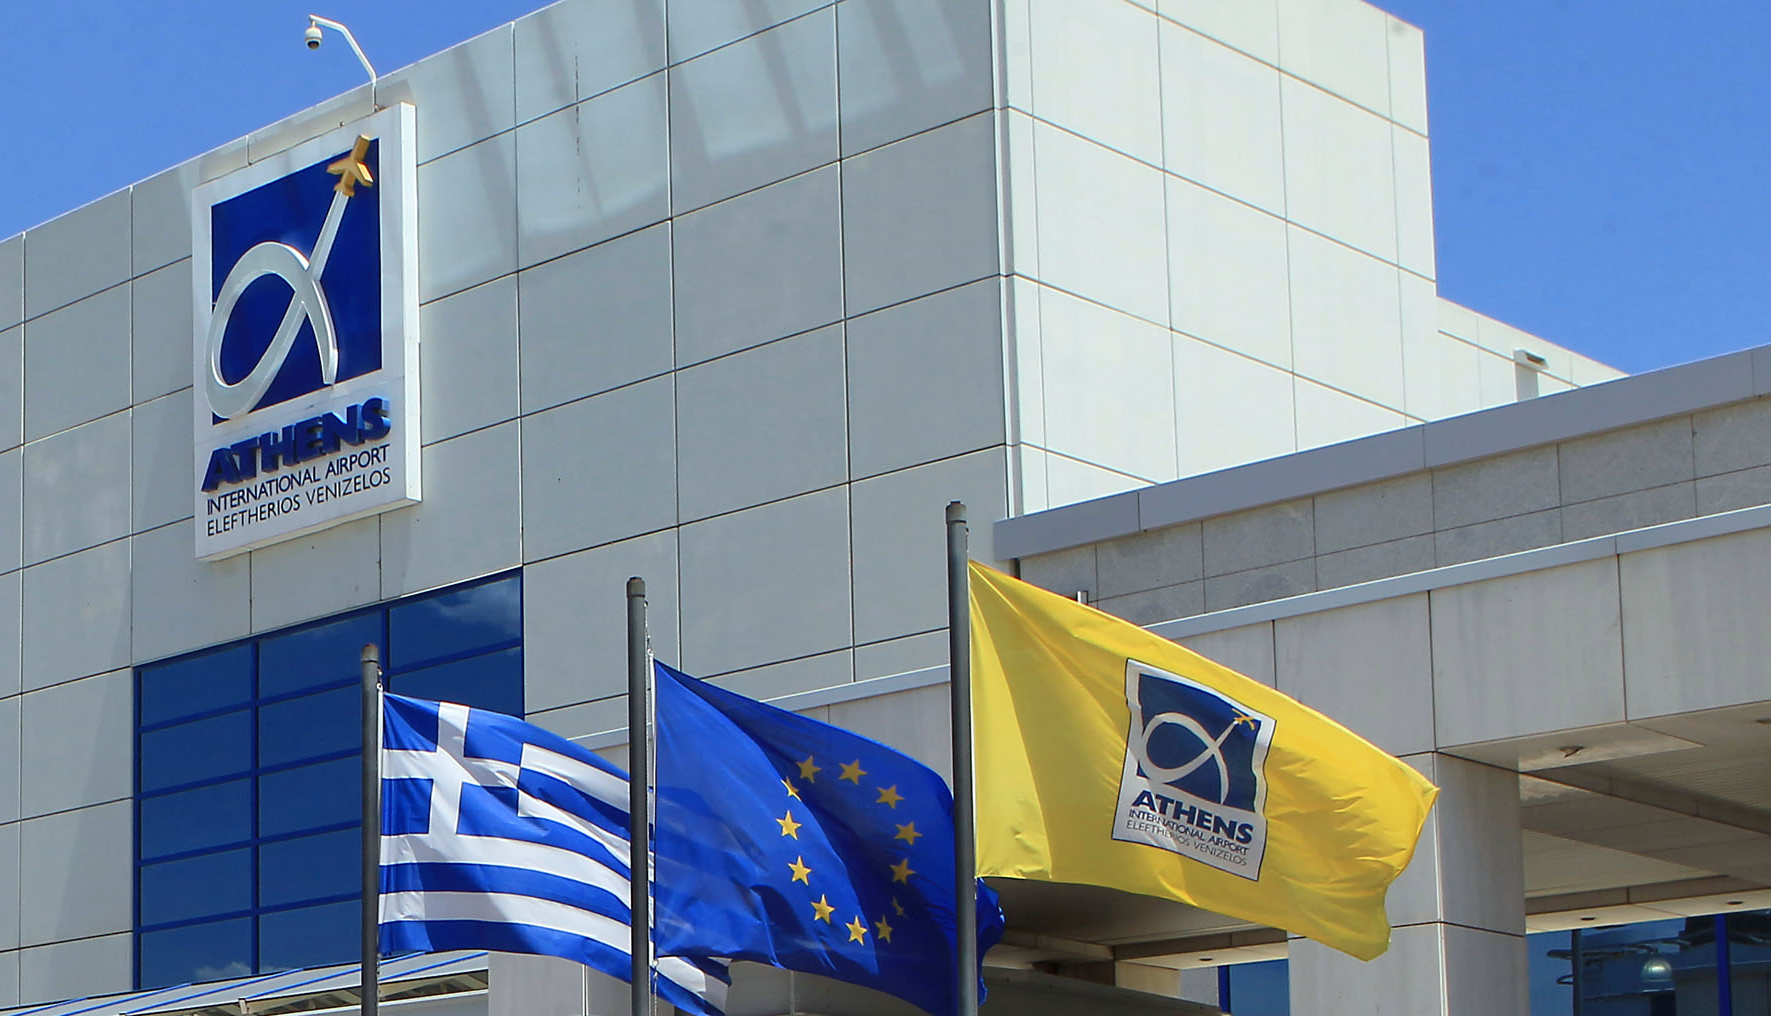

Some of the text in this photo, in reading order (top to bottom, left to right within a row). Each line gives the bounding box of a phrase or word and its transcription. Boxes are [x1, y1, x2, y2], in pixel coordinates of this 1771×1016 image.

[201, 396, 391, 492] ATHENS
[207, 444, 391, 516] INTERNATIONAL AIRPORT
[207, 467, 391, 537] ELEFTHERIOS VENIZELOS
[1127, 820, 1247, 866] ELEFTHERIOS VENIZELOS
[1129, 809, 1249, 856] INTERNATIONAL AIRPORT
[1132, 789, 1254, 844] ATHENS
